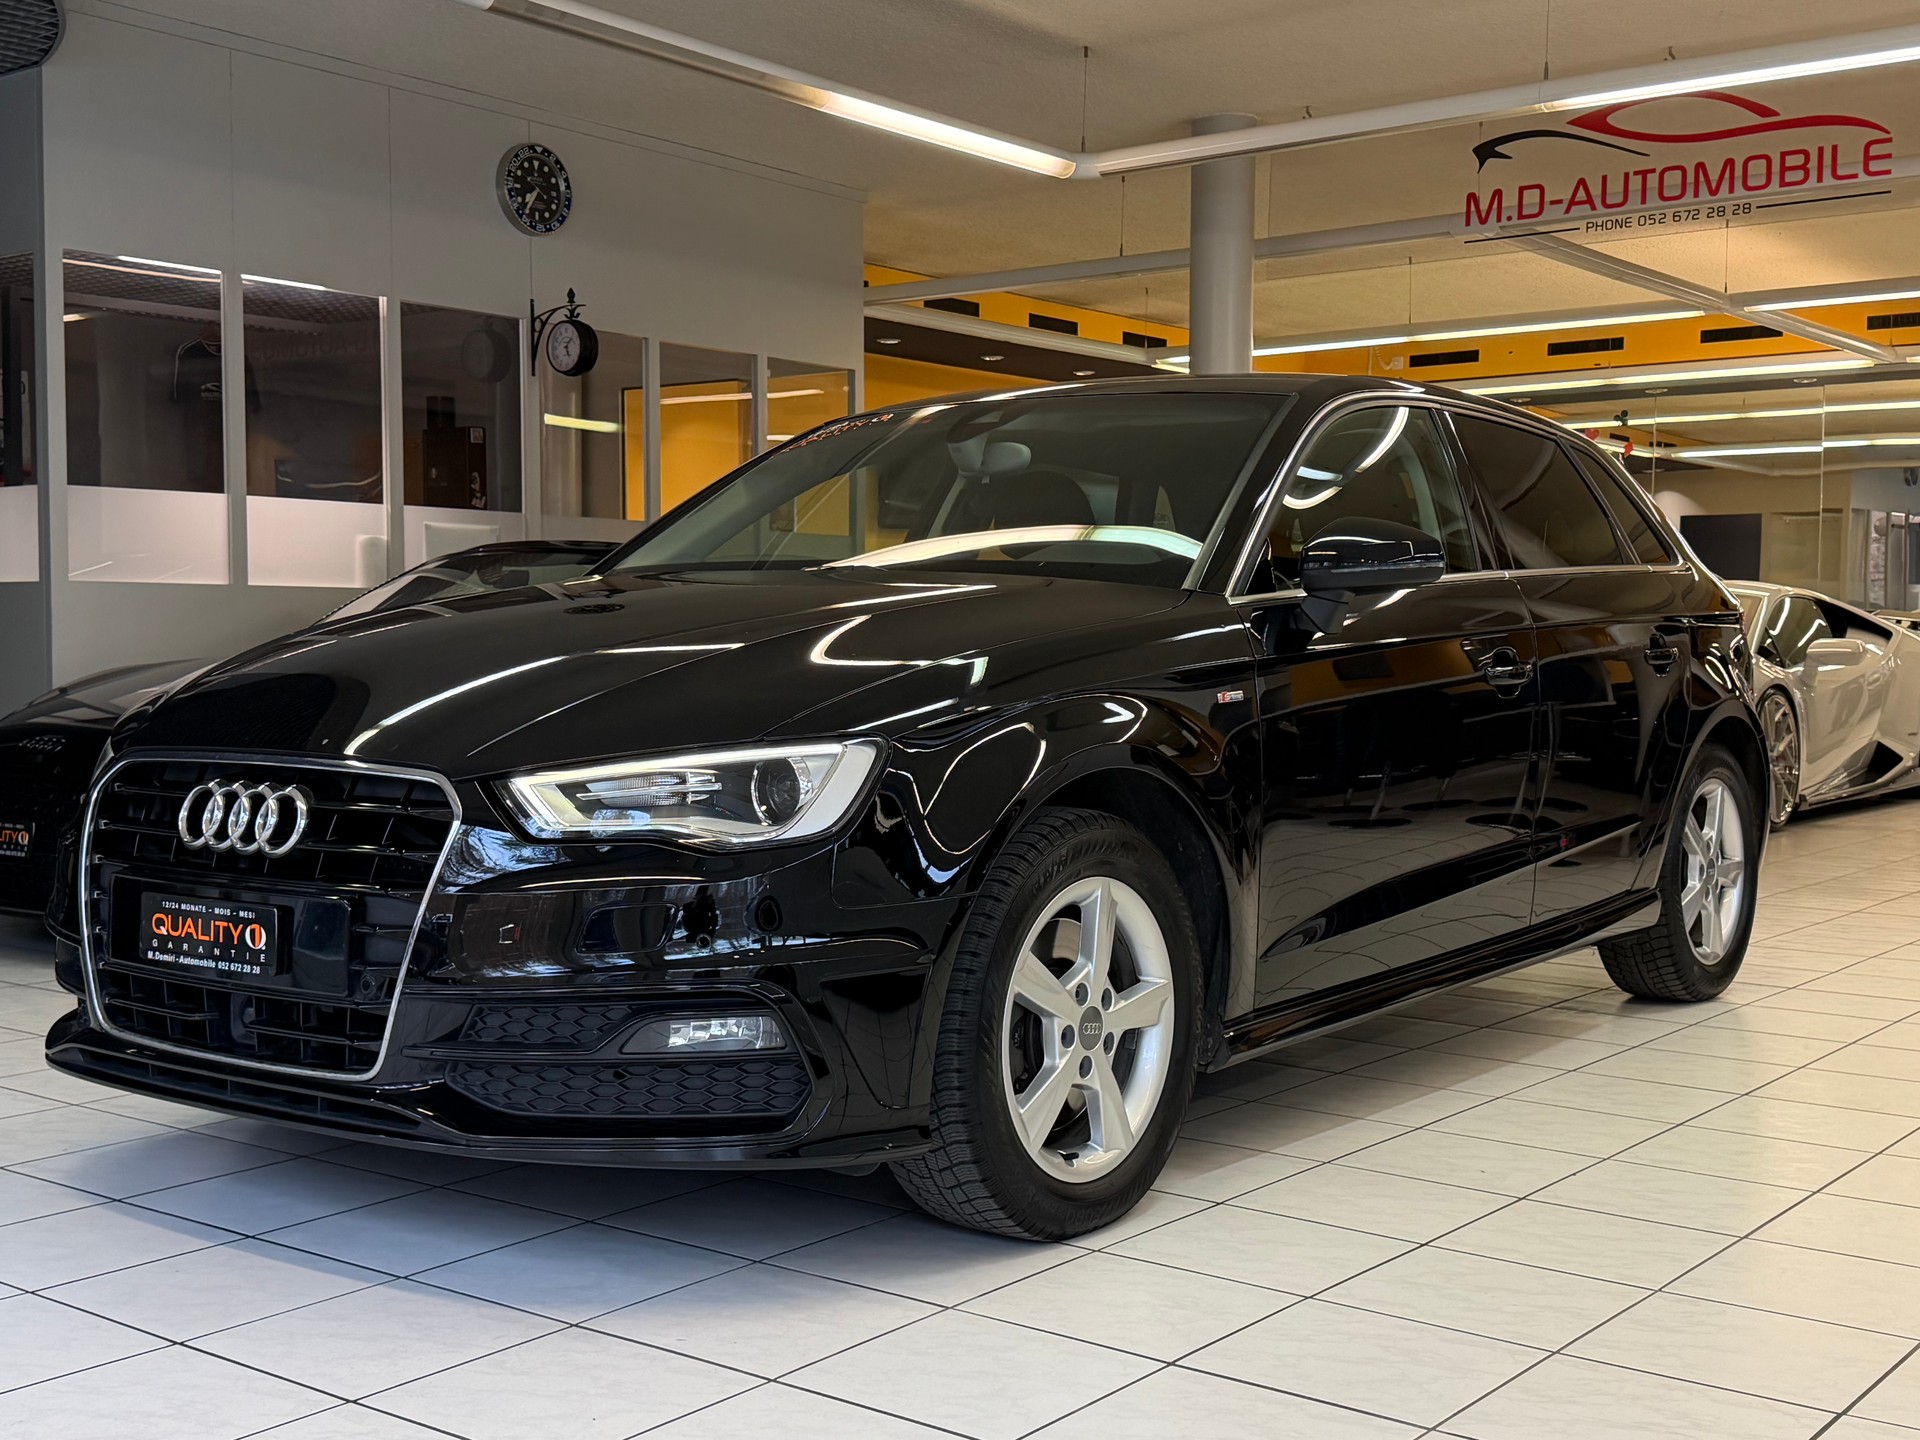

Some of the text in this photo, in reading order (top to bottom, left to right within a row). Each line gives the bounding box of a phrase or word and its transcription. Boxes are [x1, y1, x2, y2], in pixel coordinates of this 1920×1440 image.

[1464, 136, 1893, 227] M.D-AUTOMOBILE
[1586, 202, 1752, 233] PHONE 052 672 28 28
[162, 901, 179, 910] 12/24
[181, 903, 207, 913] MONATE
[214, 907, 231, 916] MOIS
[239, 910, 256, 919] MESI
[152, 912, 244, 945] QUALITY
[217, 960, 229, 970] 052
[230, 962, 242, 972] 672
[242, 964, 251, 973] 28
[252, 965, 261, 975] 28
